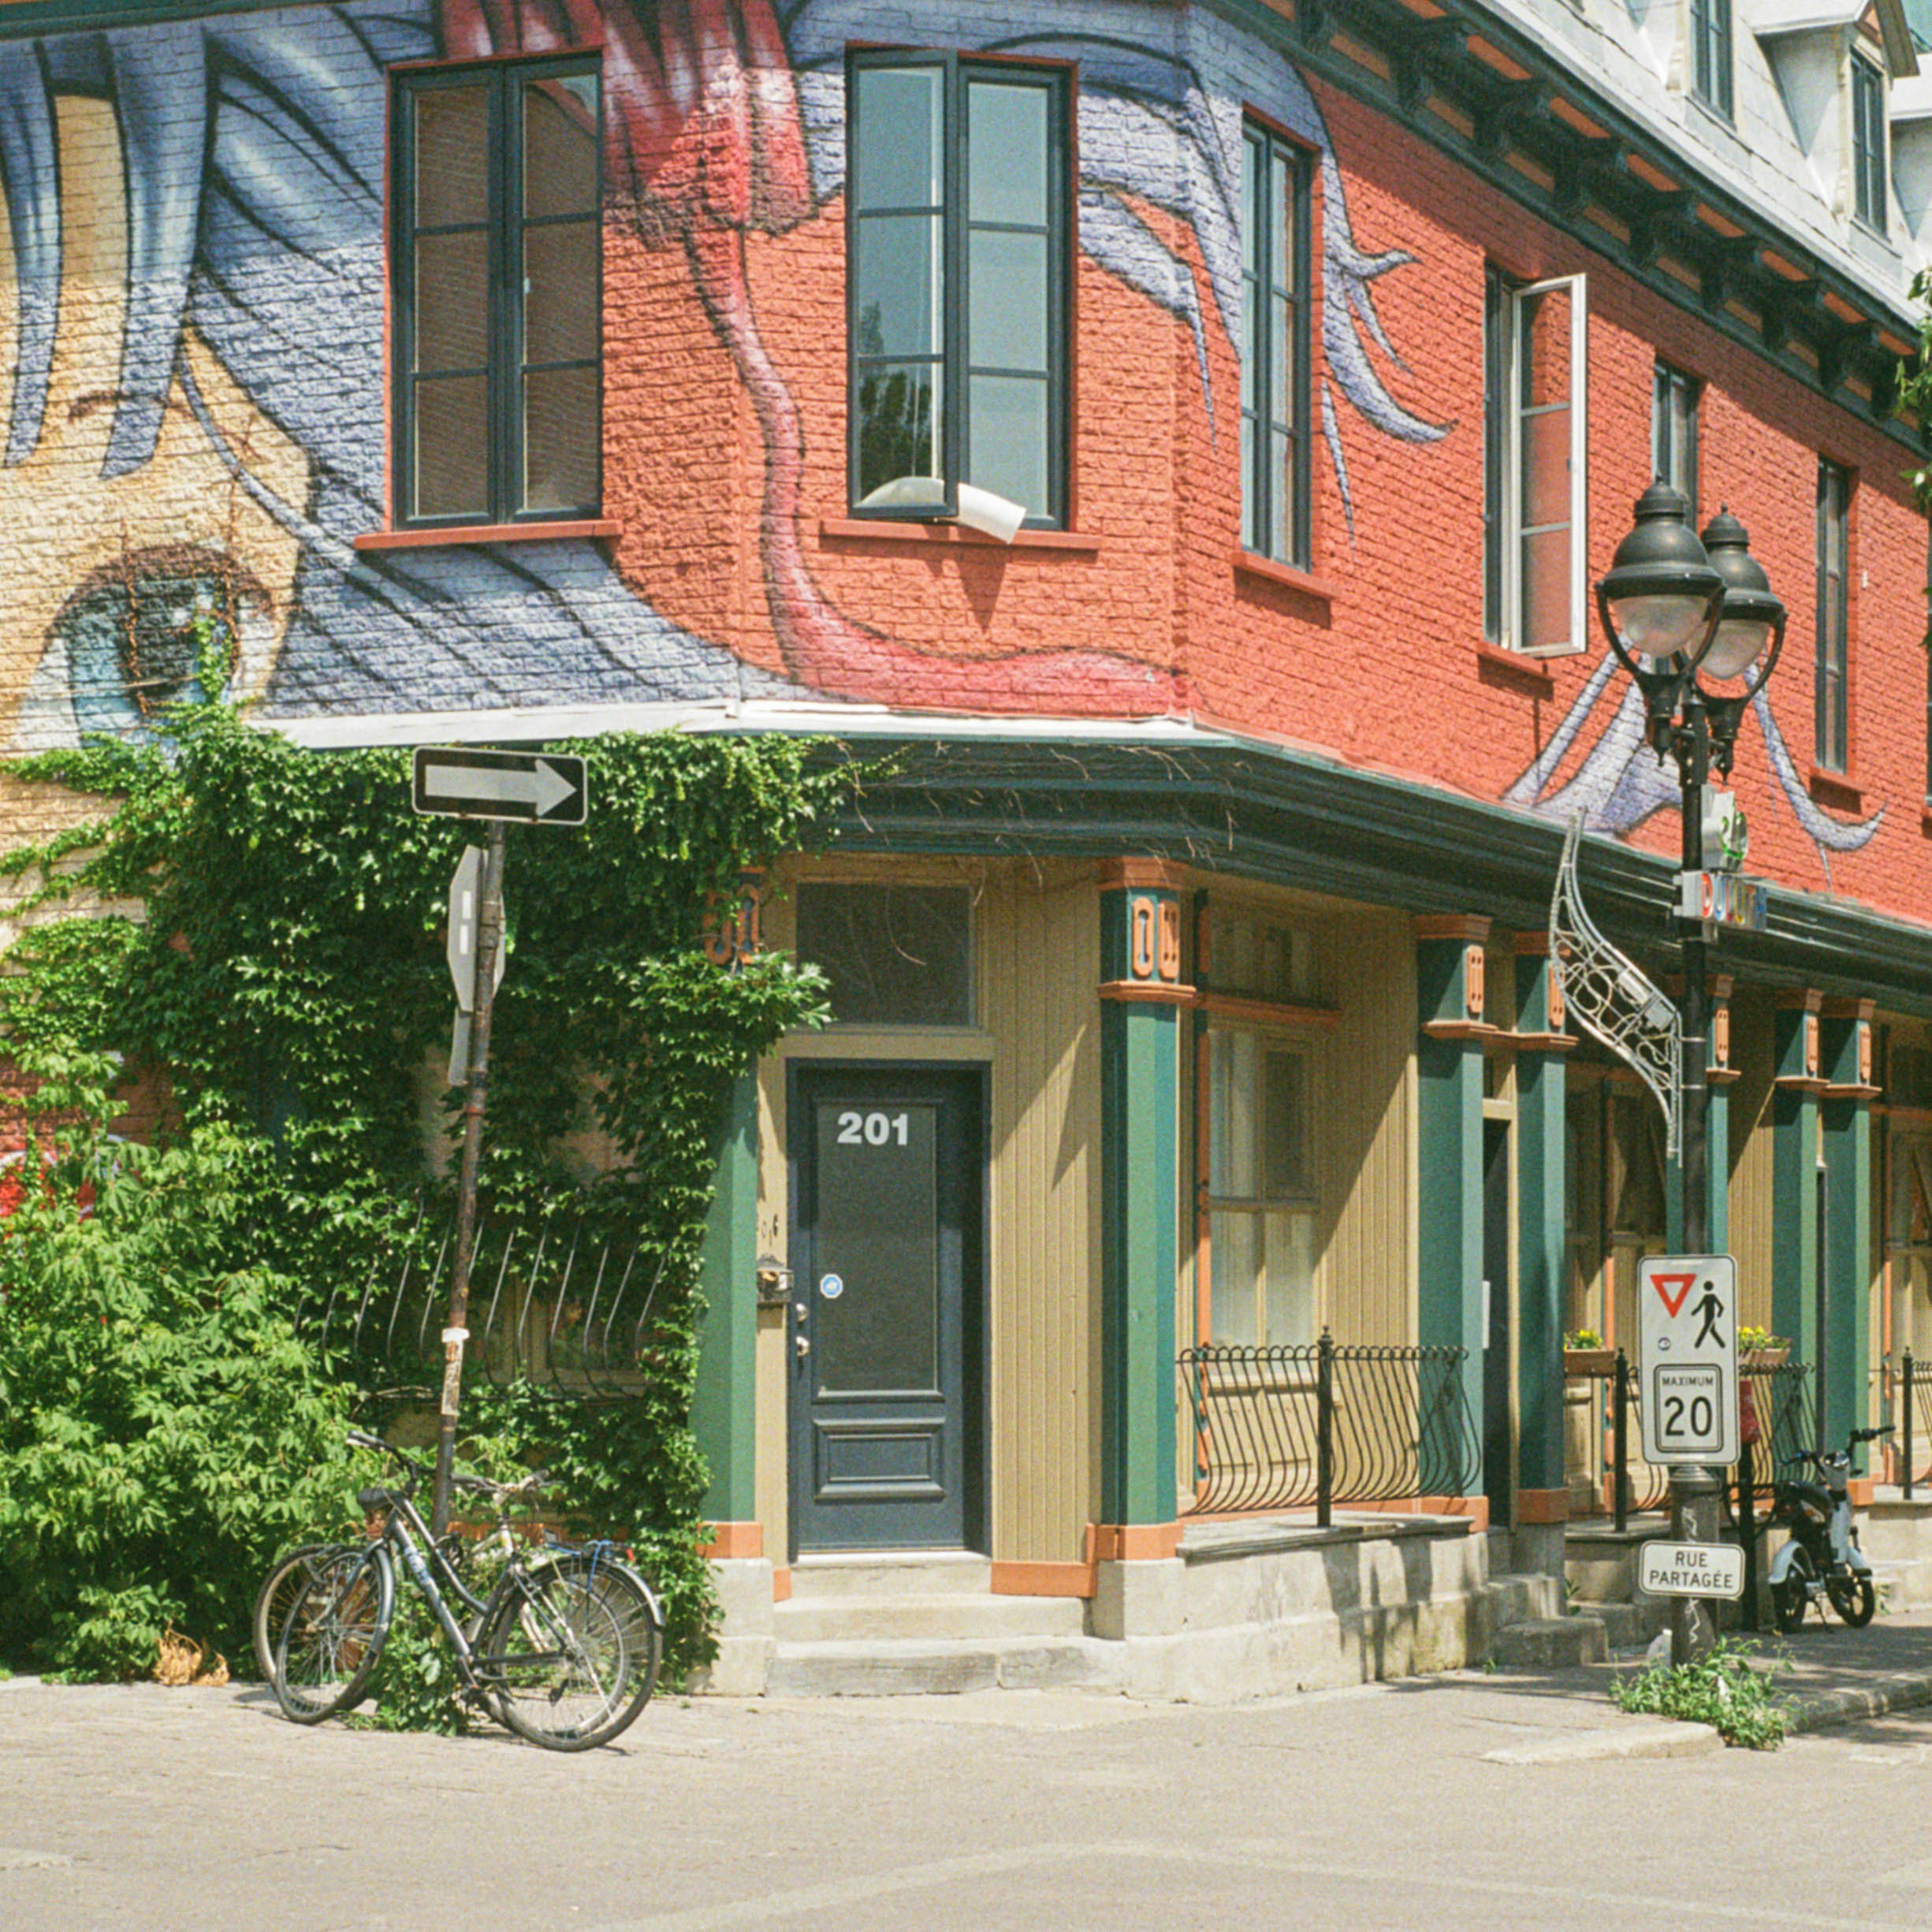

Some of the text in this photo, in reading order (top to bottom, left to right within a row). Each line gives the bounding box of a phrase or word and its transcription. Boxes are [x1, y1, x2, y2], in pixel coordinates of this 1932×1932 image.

[837, 1111, 908, 1146] 201
[1662, 1376, 1714, 1387] MAXIMUM
[1664, 1396, 1713, 1437] 20
[1675, 1550, 1708, 1568] RUE
[1649, 1569, 1734, 1588] PARTAGÉE
